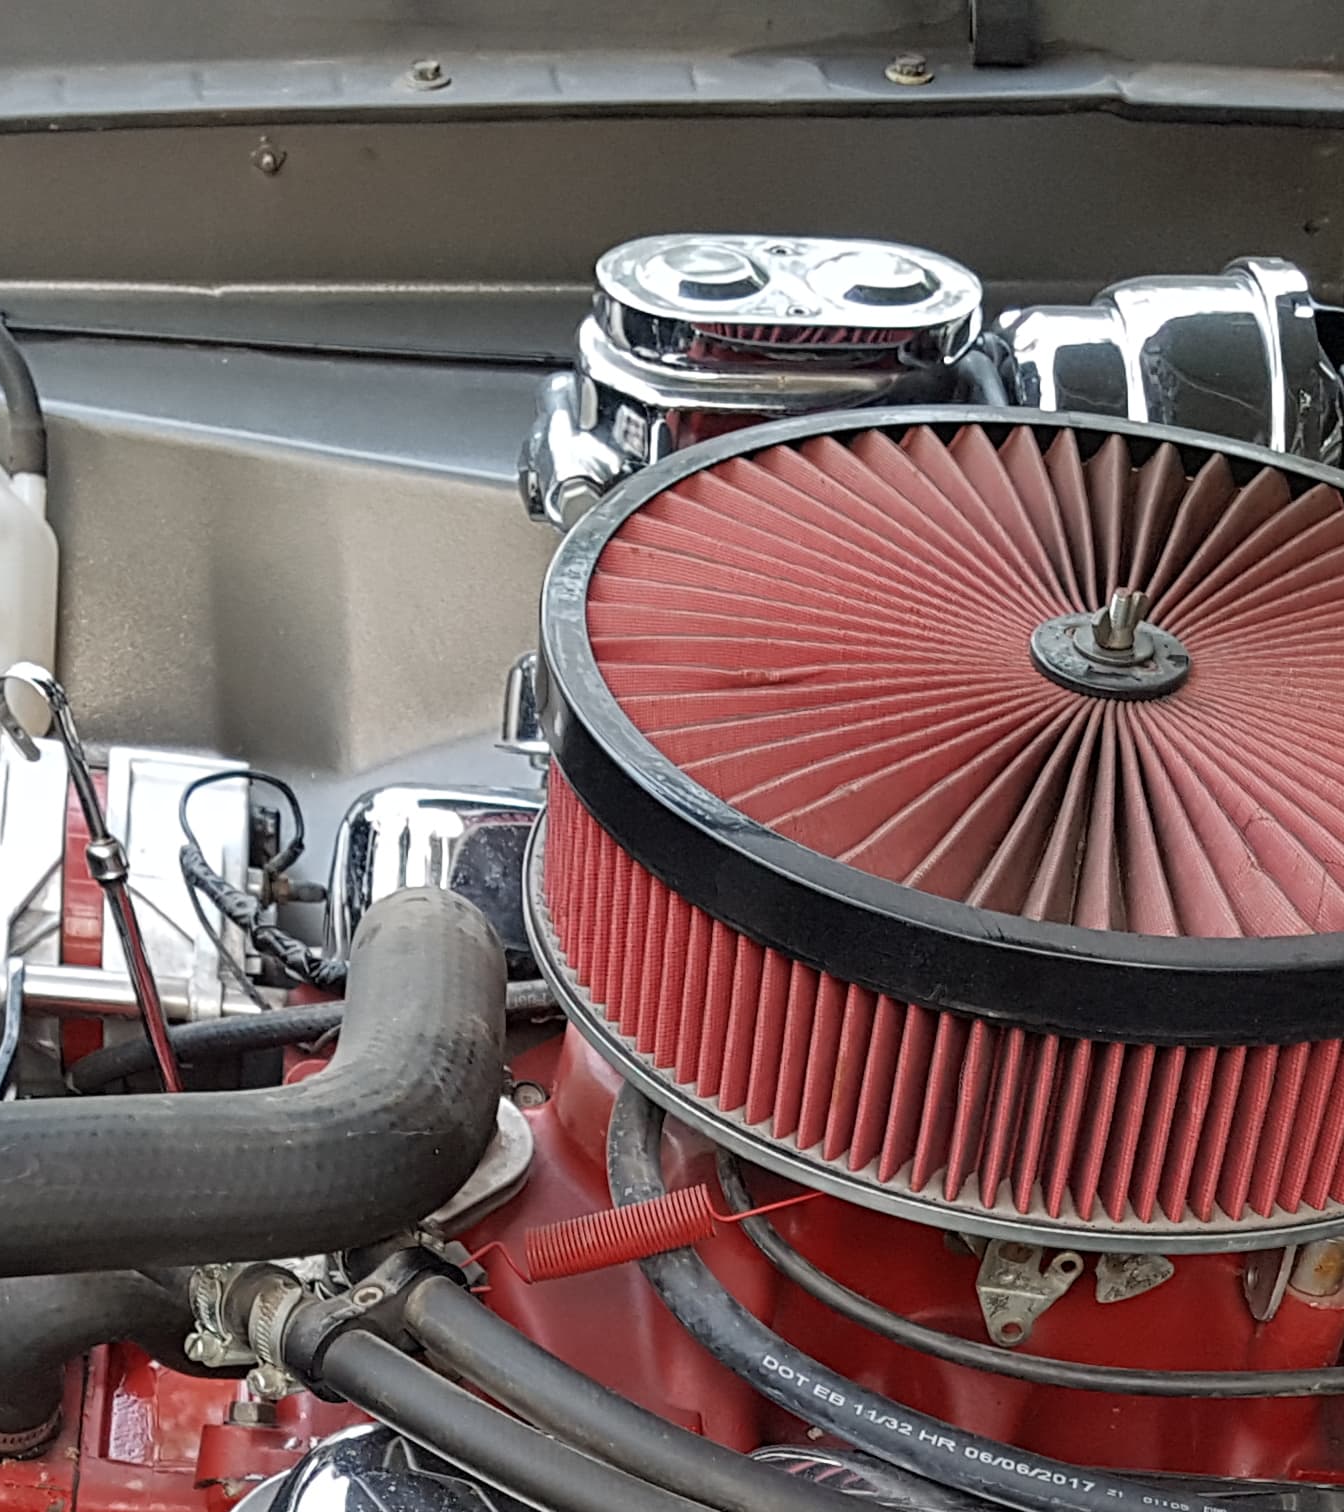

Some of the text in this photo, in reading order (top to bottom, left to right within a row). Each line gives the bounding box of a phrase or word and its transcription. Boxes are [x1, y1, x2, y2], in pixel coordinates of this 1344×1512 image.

[762, 1355, 810, 1387] DOT
[812, 1384, 845, 1407] EB
[854, 1404, 913, 1435] 11/32
[919, 1430, 956, 1452] HR
[965, 1446, 1096, 1493] 06/06/2017
